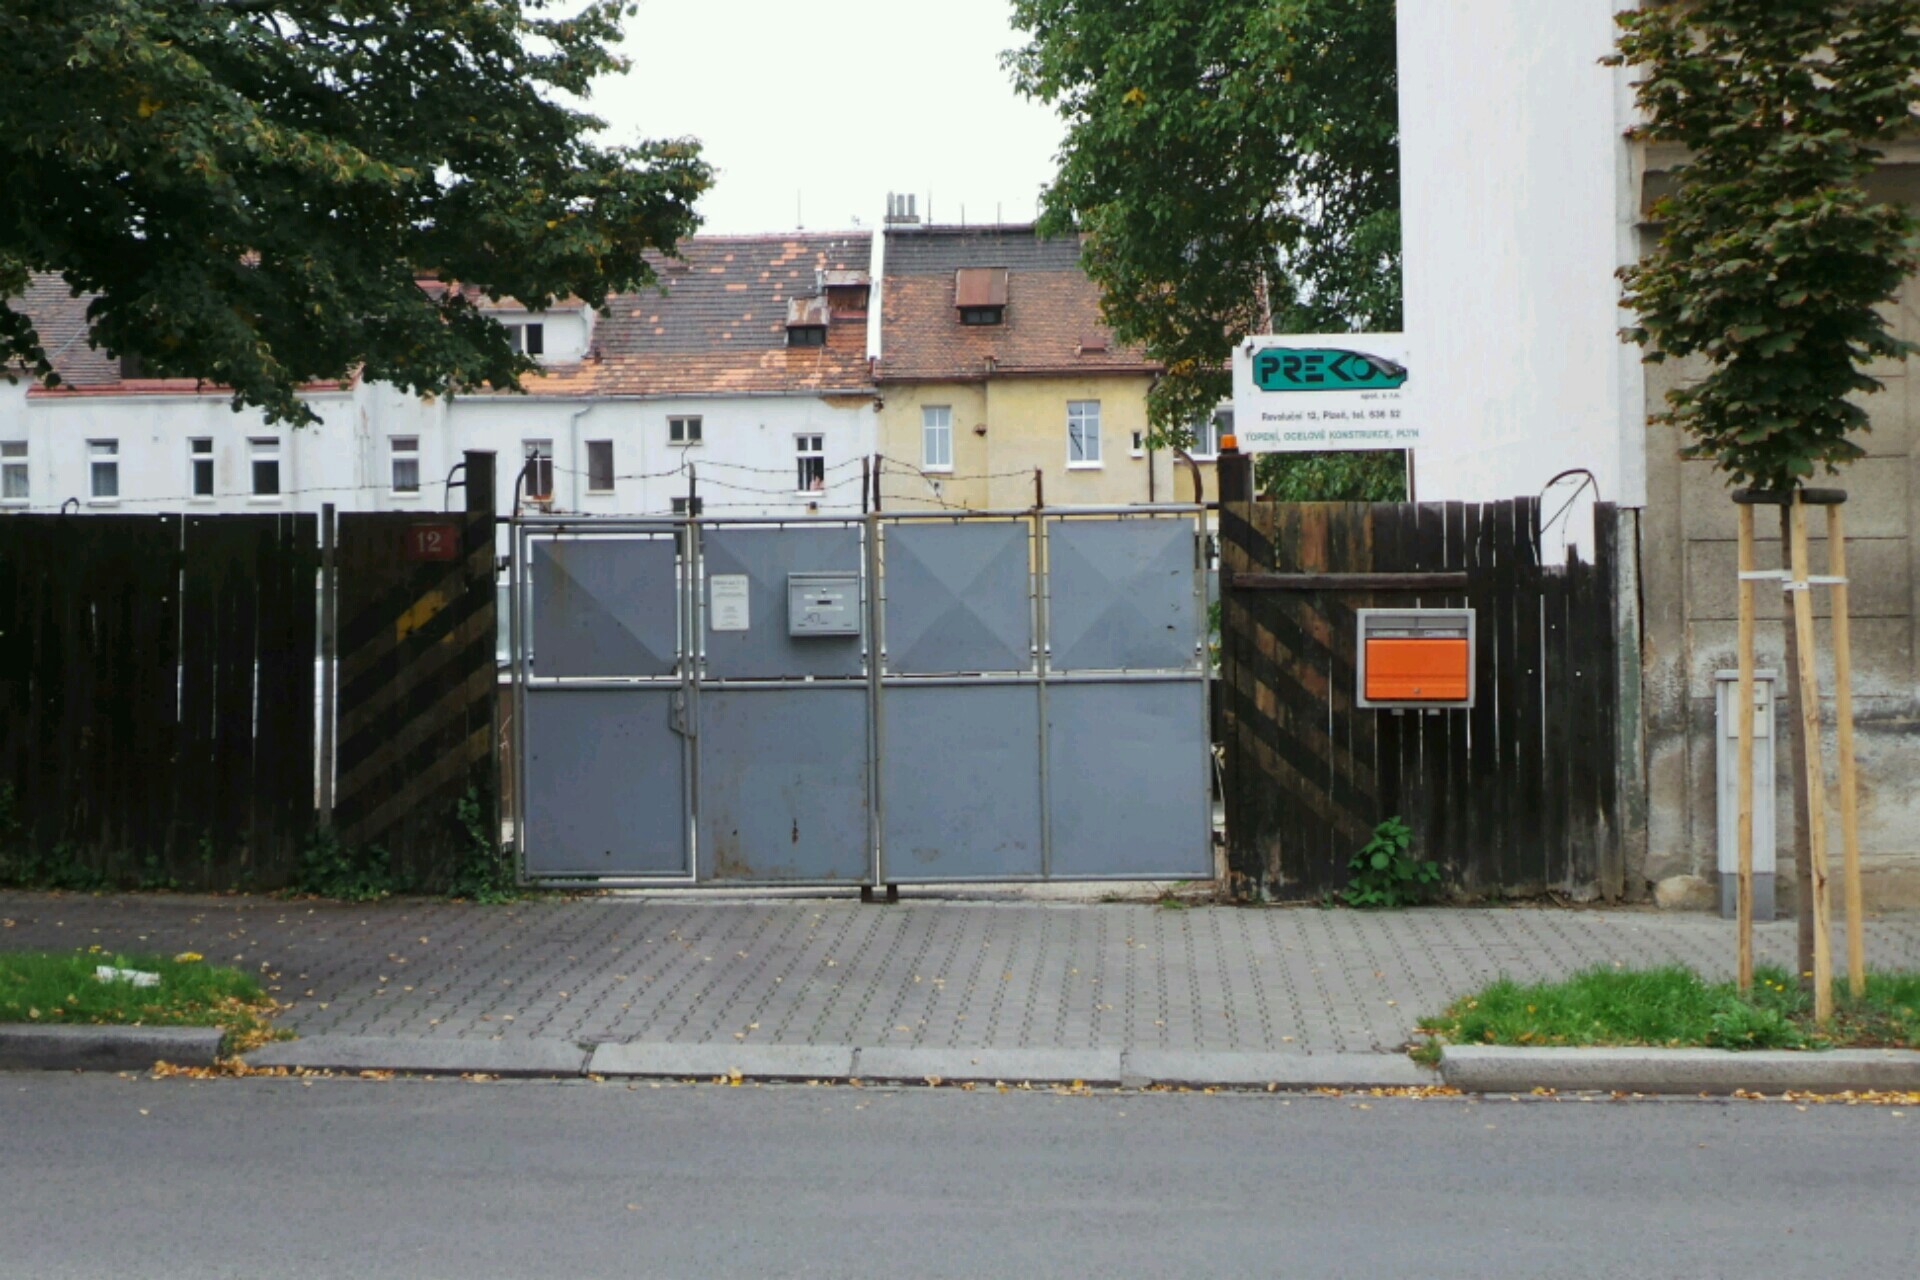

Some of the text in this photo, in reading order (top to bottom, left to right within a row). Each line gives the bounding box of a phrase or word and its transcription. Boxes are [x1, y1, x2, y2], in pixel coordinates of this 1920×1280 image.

[1261, 354, 1379, 384] PREKO
[1284, 429, 1325, 441] OCELOVÉ
[1329, 430, 1393, 441] KONSTRUKCE,
[1397, 429, 1419, 439] PLYN
[416, 531, 442, 553] 12
